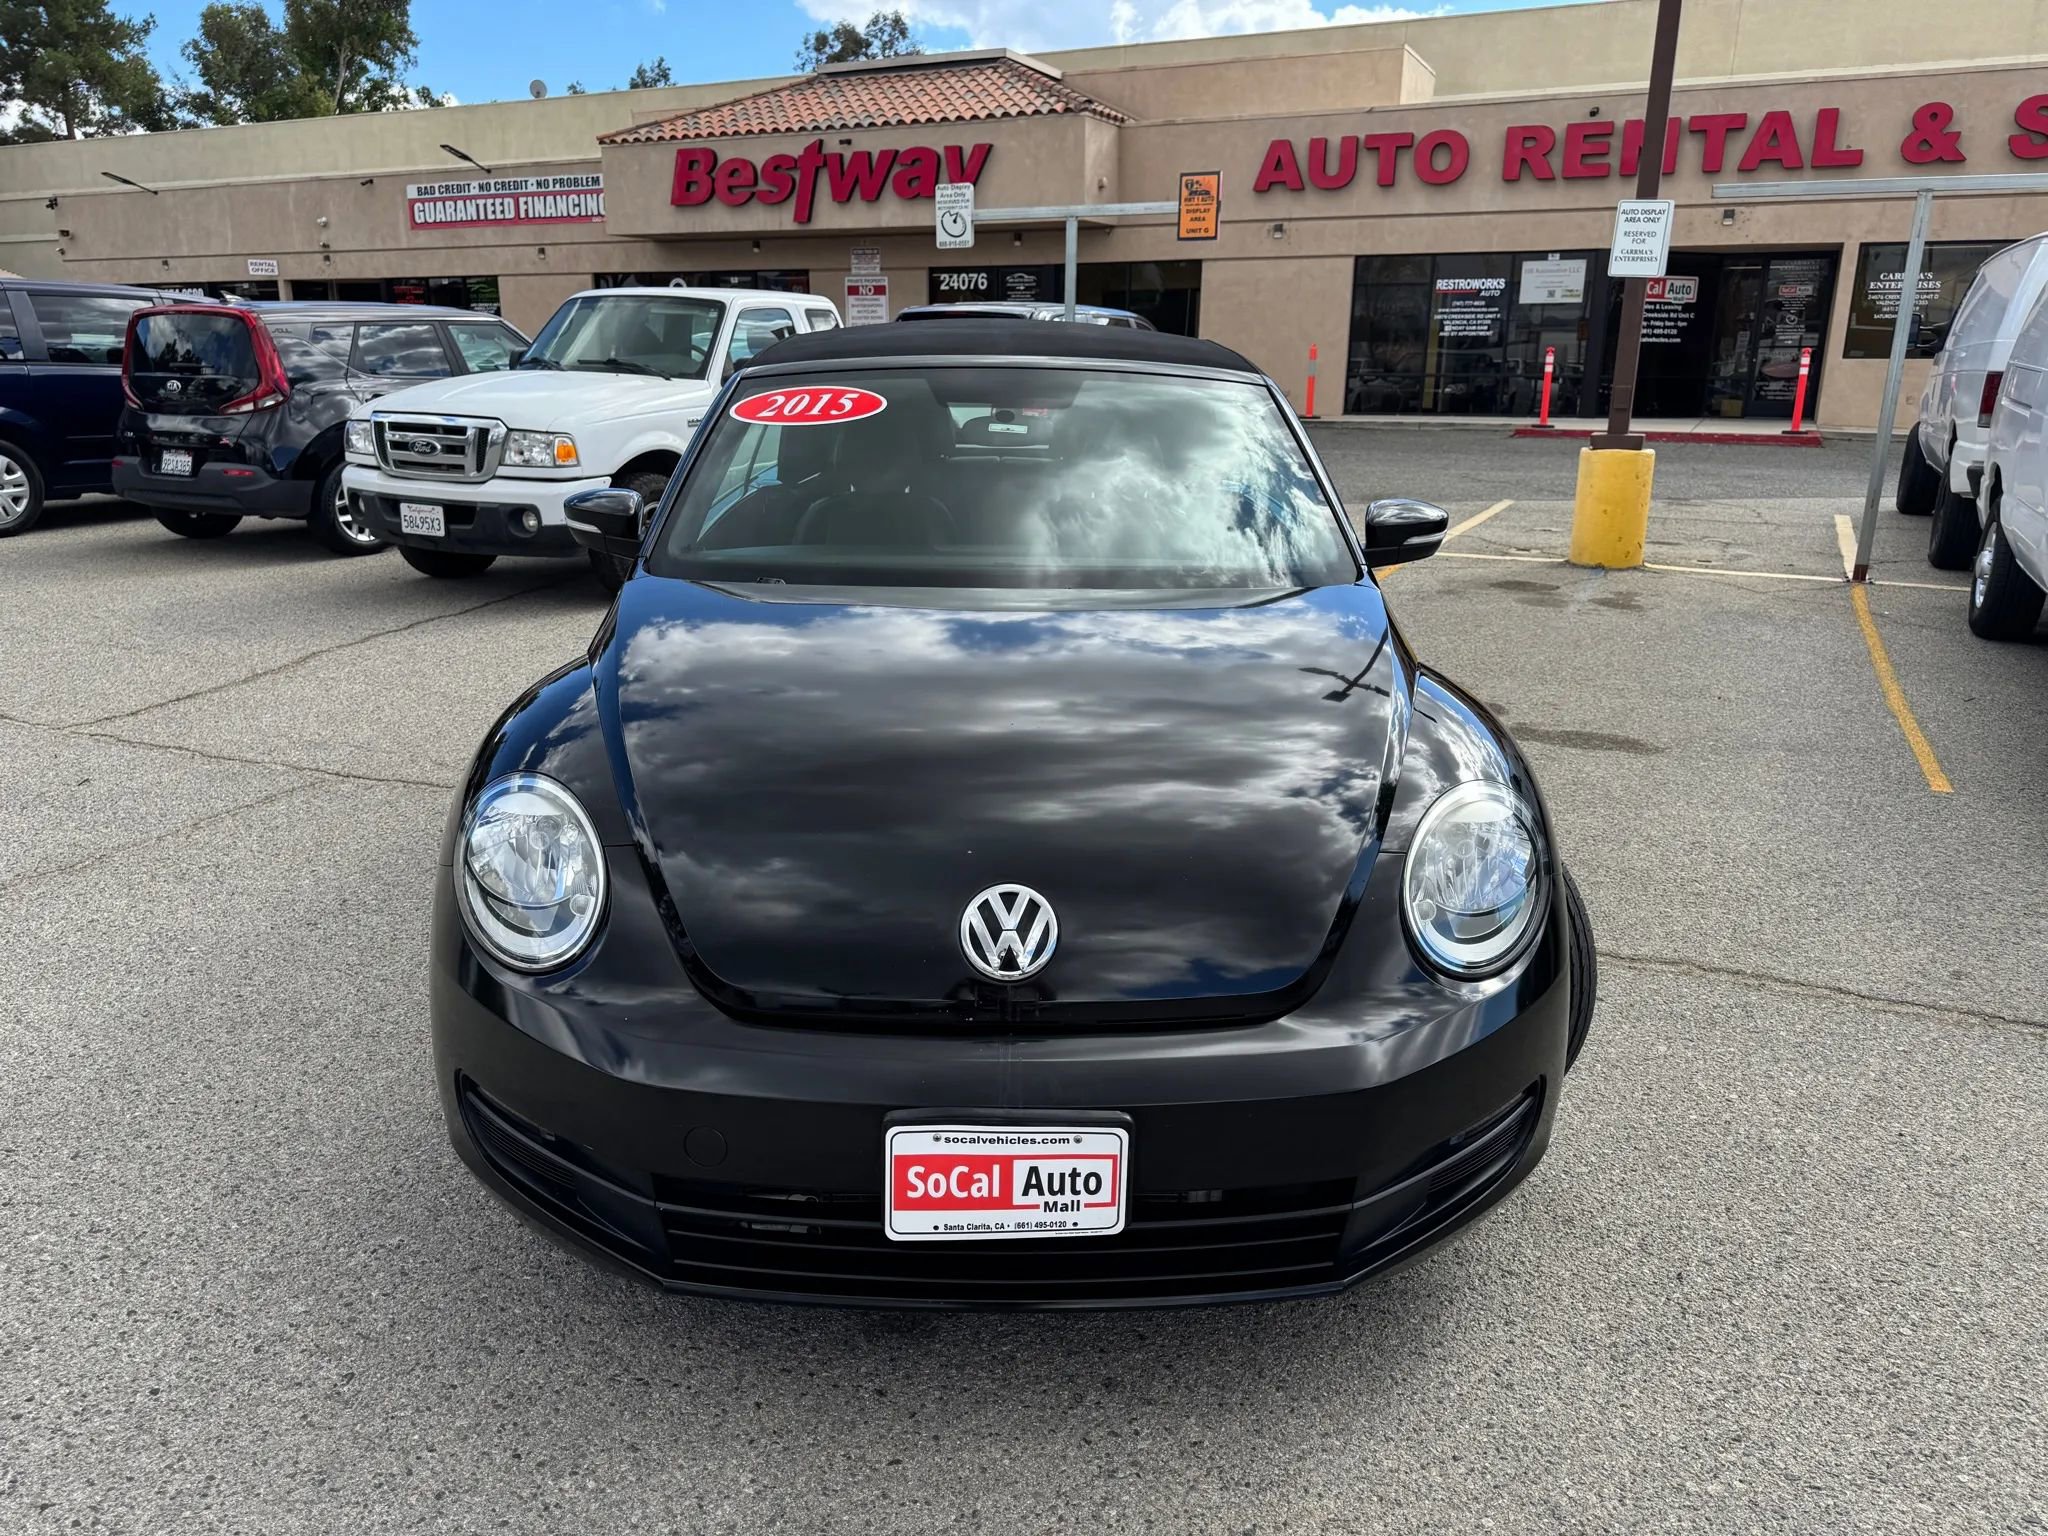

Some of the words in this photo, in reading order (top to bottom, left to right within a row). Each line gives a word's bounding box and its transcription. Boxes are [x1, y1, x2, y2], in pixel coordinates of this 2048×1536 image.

[1253, 129, 1470, 193] AUTO
[1502, 107, 1864, 182] RENTAL
[1901, 101, 1967, 165] &
[2008, 93, 2048, 160] S
[417, 185, 436, 197] BAD
[438, 183, 471, 195] CREDIT
[478, 181, 492, 193] NO
[494, 179, 529, 192] CREDIT
[536, 177, 550, 190] NO
[552, 176, 600, 188] PROBLEM
[670, 138, 993, 223] Bestway
[413, 197, 516, 224] GUARANTEED
[940, 272, 988, 290] 24076
[1436, 278, 1506, 290] RESTROWORKS
[1648, 280, 1663, 295] Cal
[1668, 282, 1692, 295] Auto
[1869, 281, 1942, 289] ENTERISES
[859, 286, 874, 296] NO
[756, 392, 860, 418] 2015
[414, 441, 432, 453] Ford
[403, 514, 441, 532] 58495X3
[944, 1135, 1070, 1145] socalvehicles.com
[906, 1164, 1000, 1199] SoCal
[1021, 1165, 1103, 1197] Auto
[1043, 1200, 1080, 1213] Mall
[966, 1222, 993, 1232] Clarita,
[1014, 1222, 1033, 1230] (661)
[1034, 1221, 1067, 1229] 495-0120
